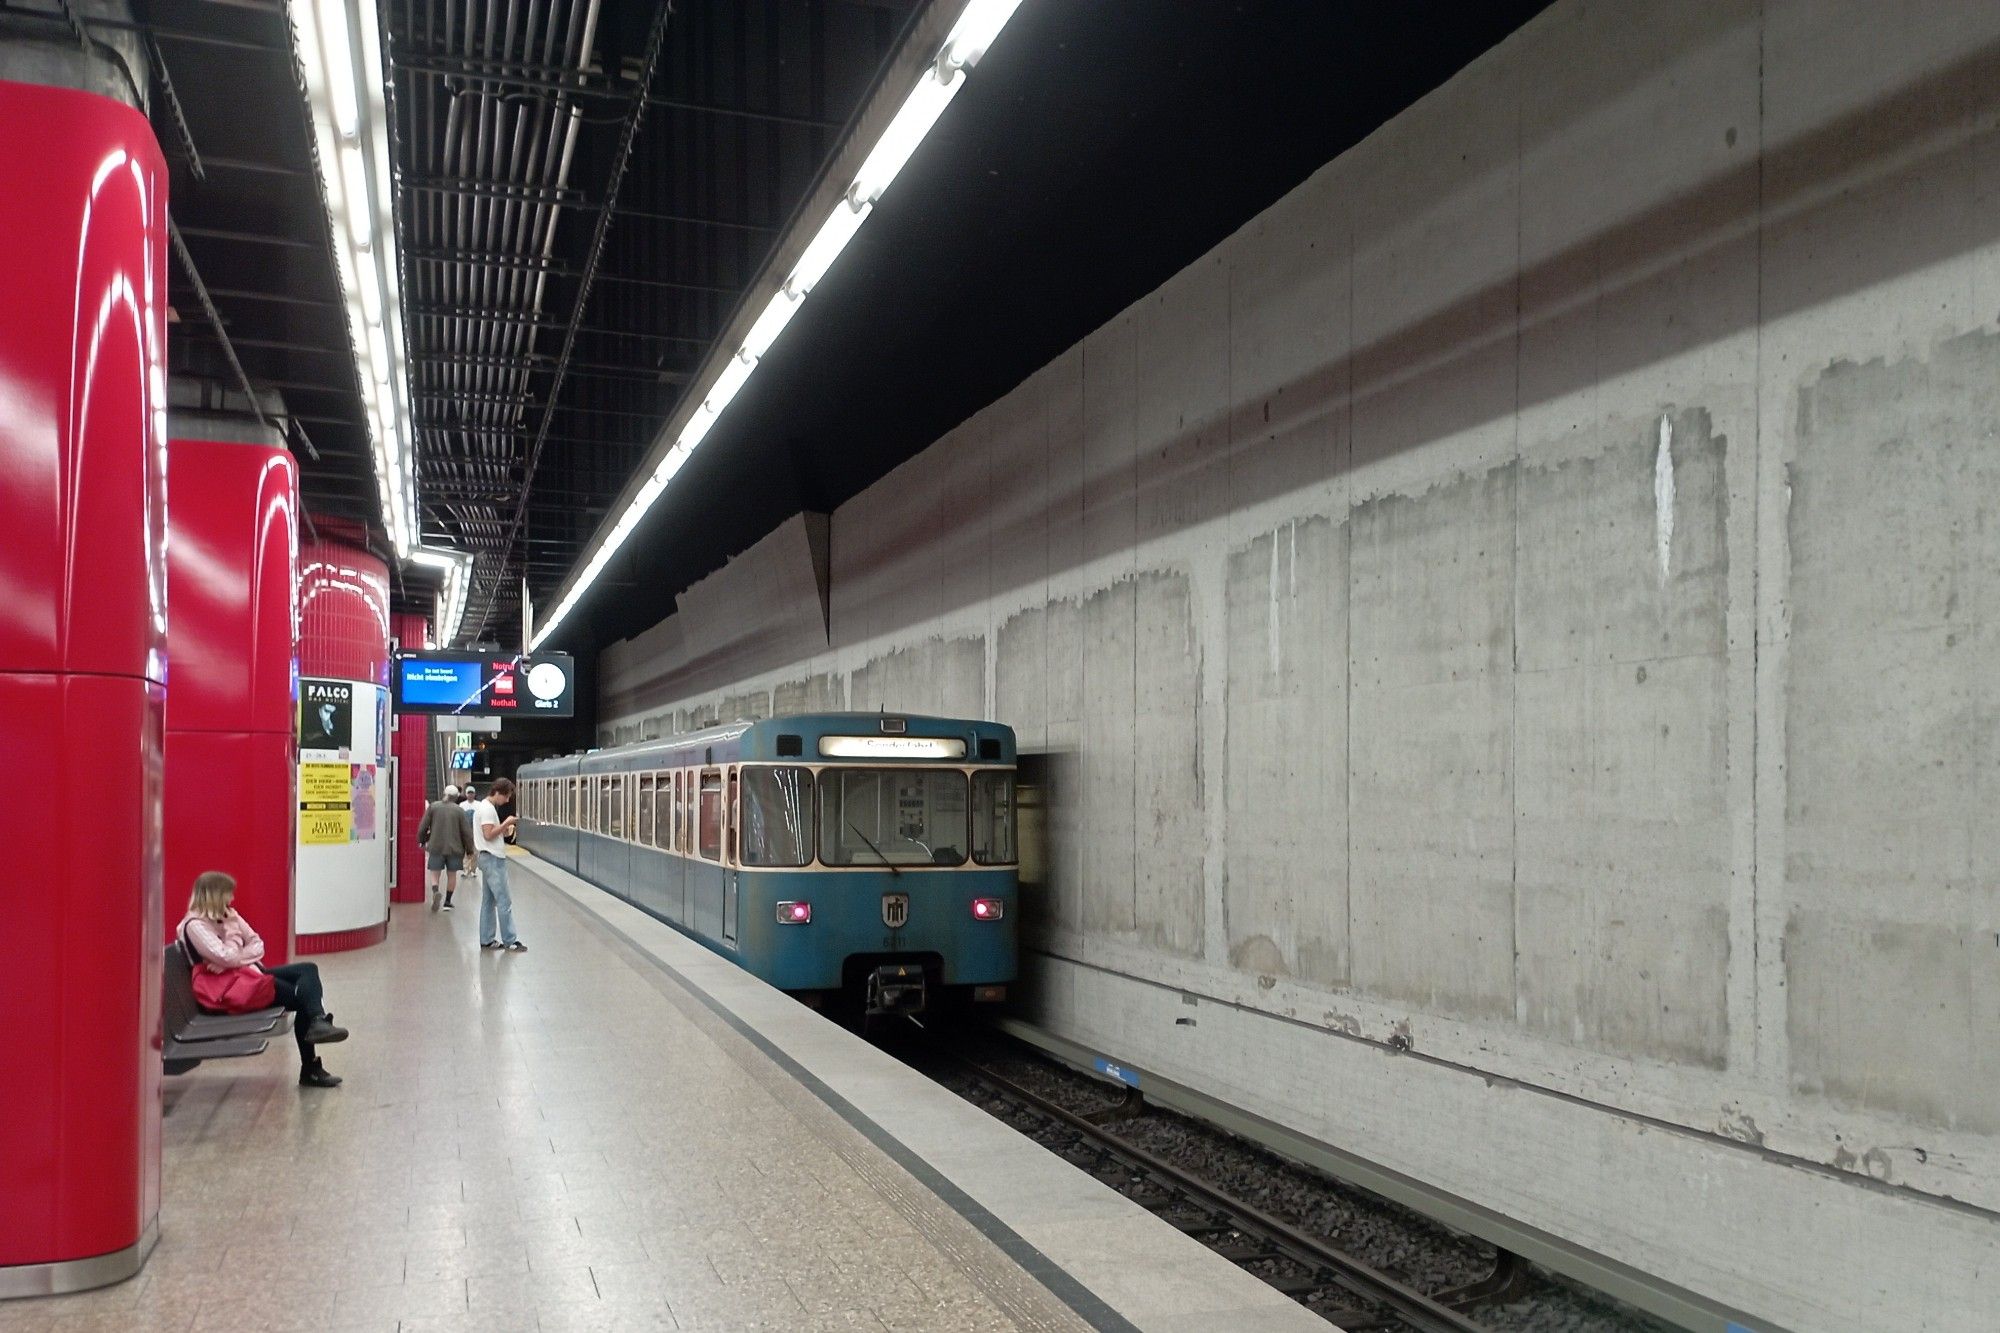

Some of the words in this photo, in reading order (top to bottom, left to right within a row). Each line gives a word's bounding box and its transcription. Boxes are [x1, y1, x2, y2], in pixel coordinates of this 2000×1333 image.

[308, 685, 349, 699] FALCO
[491, 699, 517, 707] Nothalt
[553, 700, 558, 708] 2
